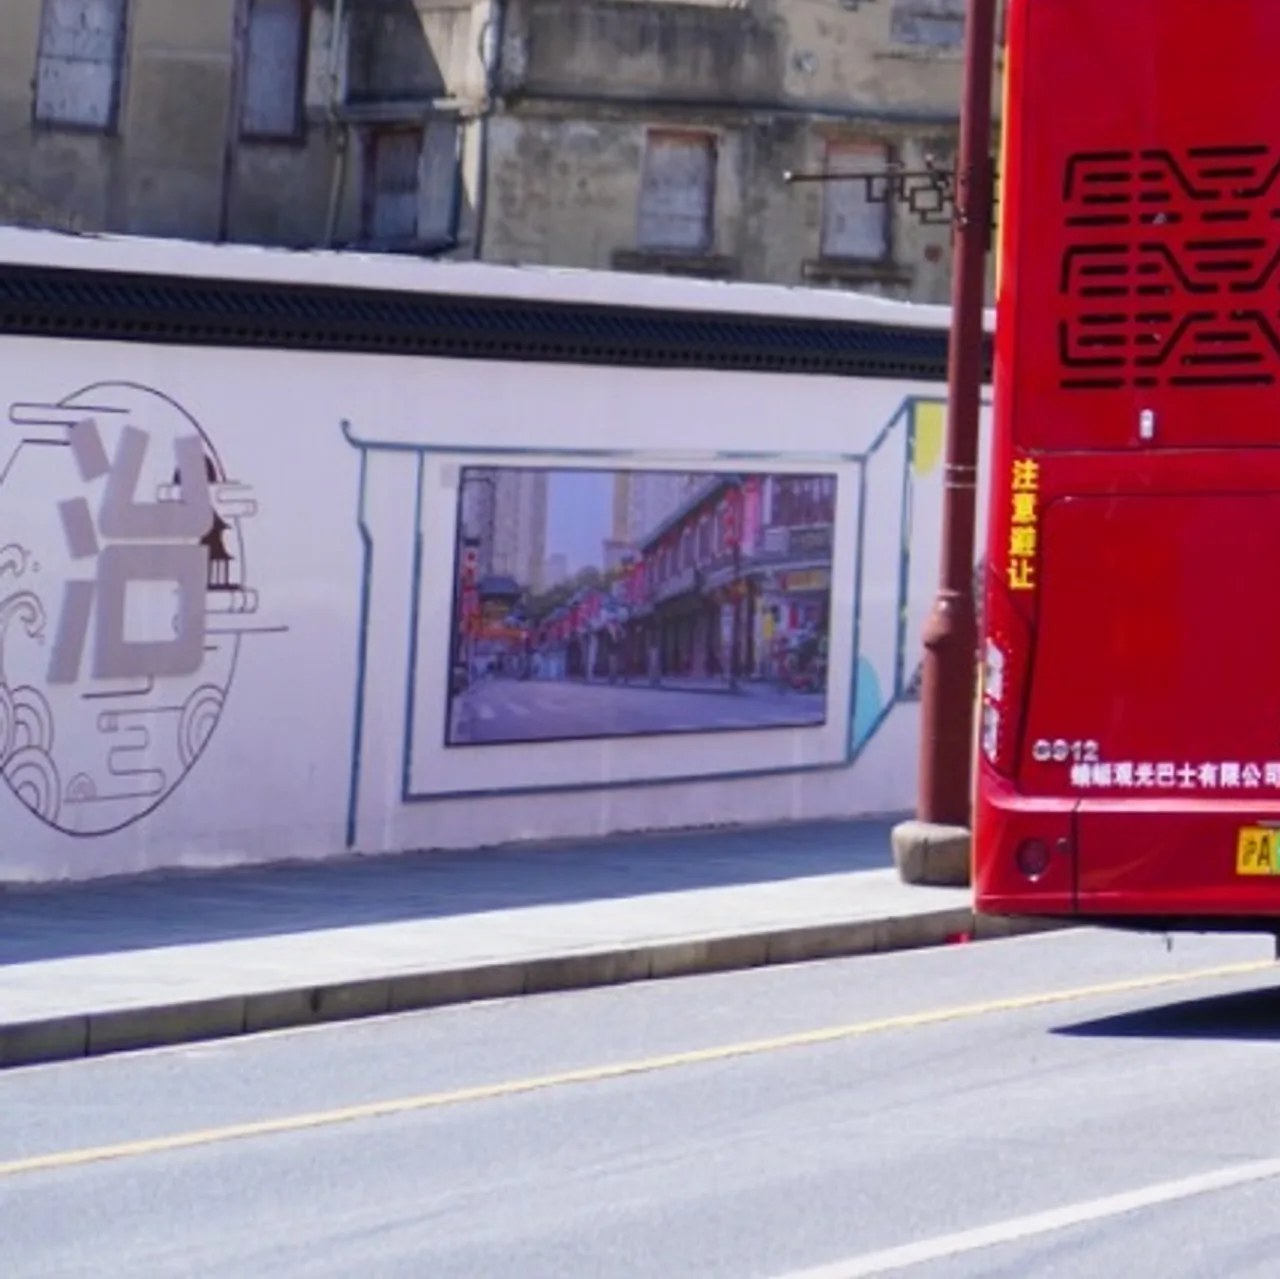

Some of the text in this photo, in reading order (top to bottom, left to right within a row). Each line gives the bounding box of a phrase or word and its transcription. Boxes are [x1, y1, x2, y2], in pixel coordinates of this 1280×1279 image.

[46, 417, 214, 685] 治
[1007, 459, 1039, 589] 注意避让
